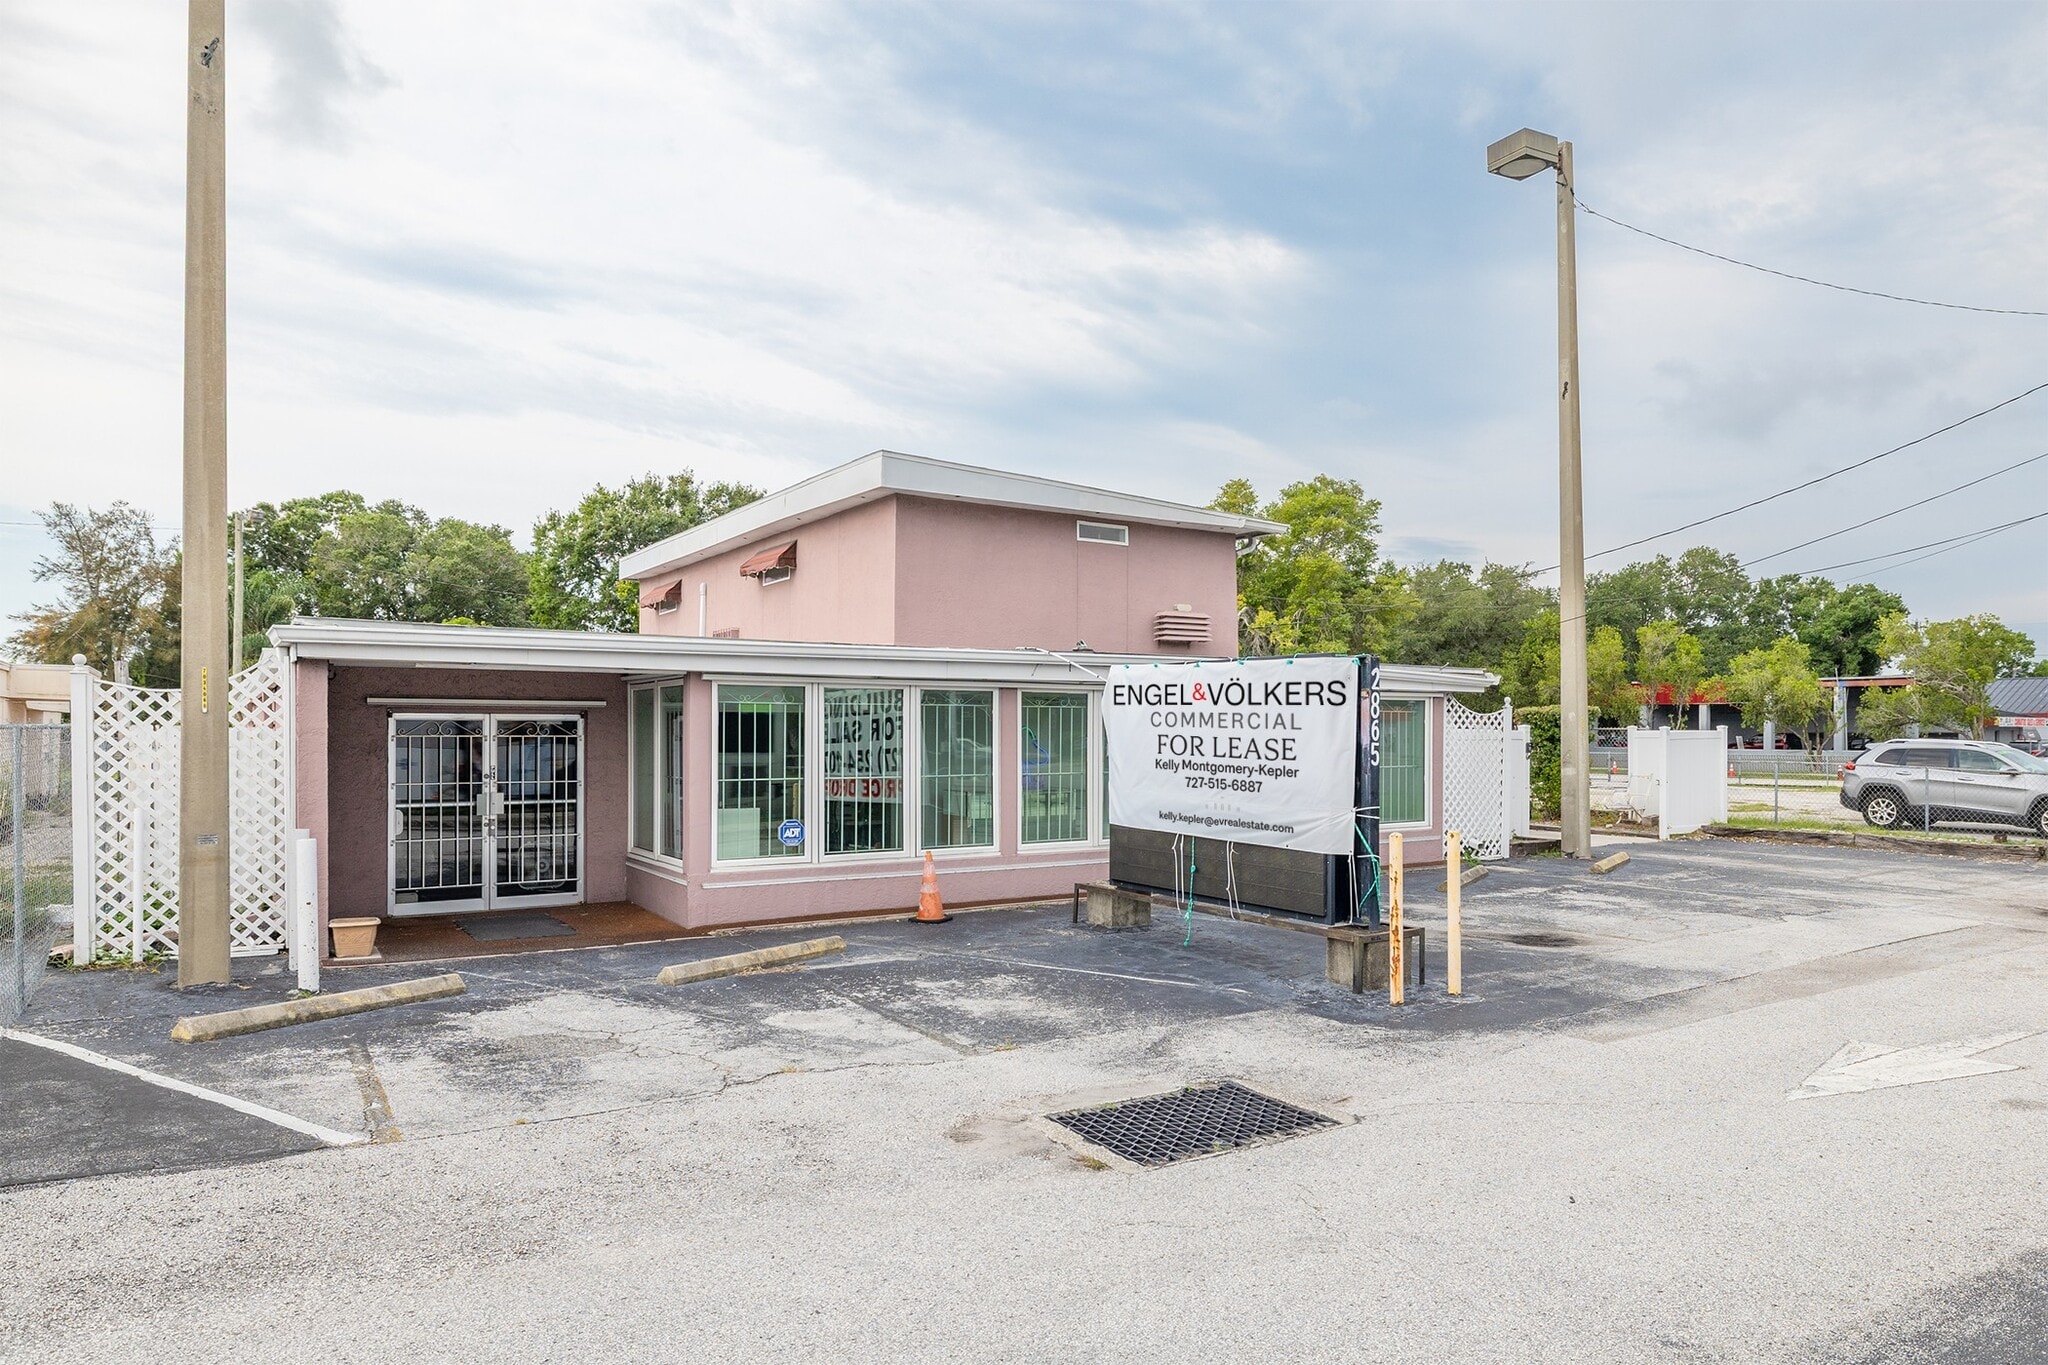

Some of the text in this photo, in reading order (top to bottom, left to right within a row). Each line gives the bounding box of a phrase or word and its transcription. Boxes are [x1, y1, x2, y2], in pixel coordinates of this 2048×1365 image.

[1113, 677, 1347, 706] ENGEL&VÖLKERS
[1150, 711, 1302, 730] COMMERCIAL
[1370, 667, 1380, 766] 2865
[1157, 734, 1297, 761] FOR LEASE
[1155, 758, 1299, 780] Kelly Montgomery-Kepler
[1185, 776, 1263, 793] 727-515-6887
[784, 828, 801, 838] ADT
[1159, 810, 1295, 834] kelly.kepler@evrealestate.com
